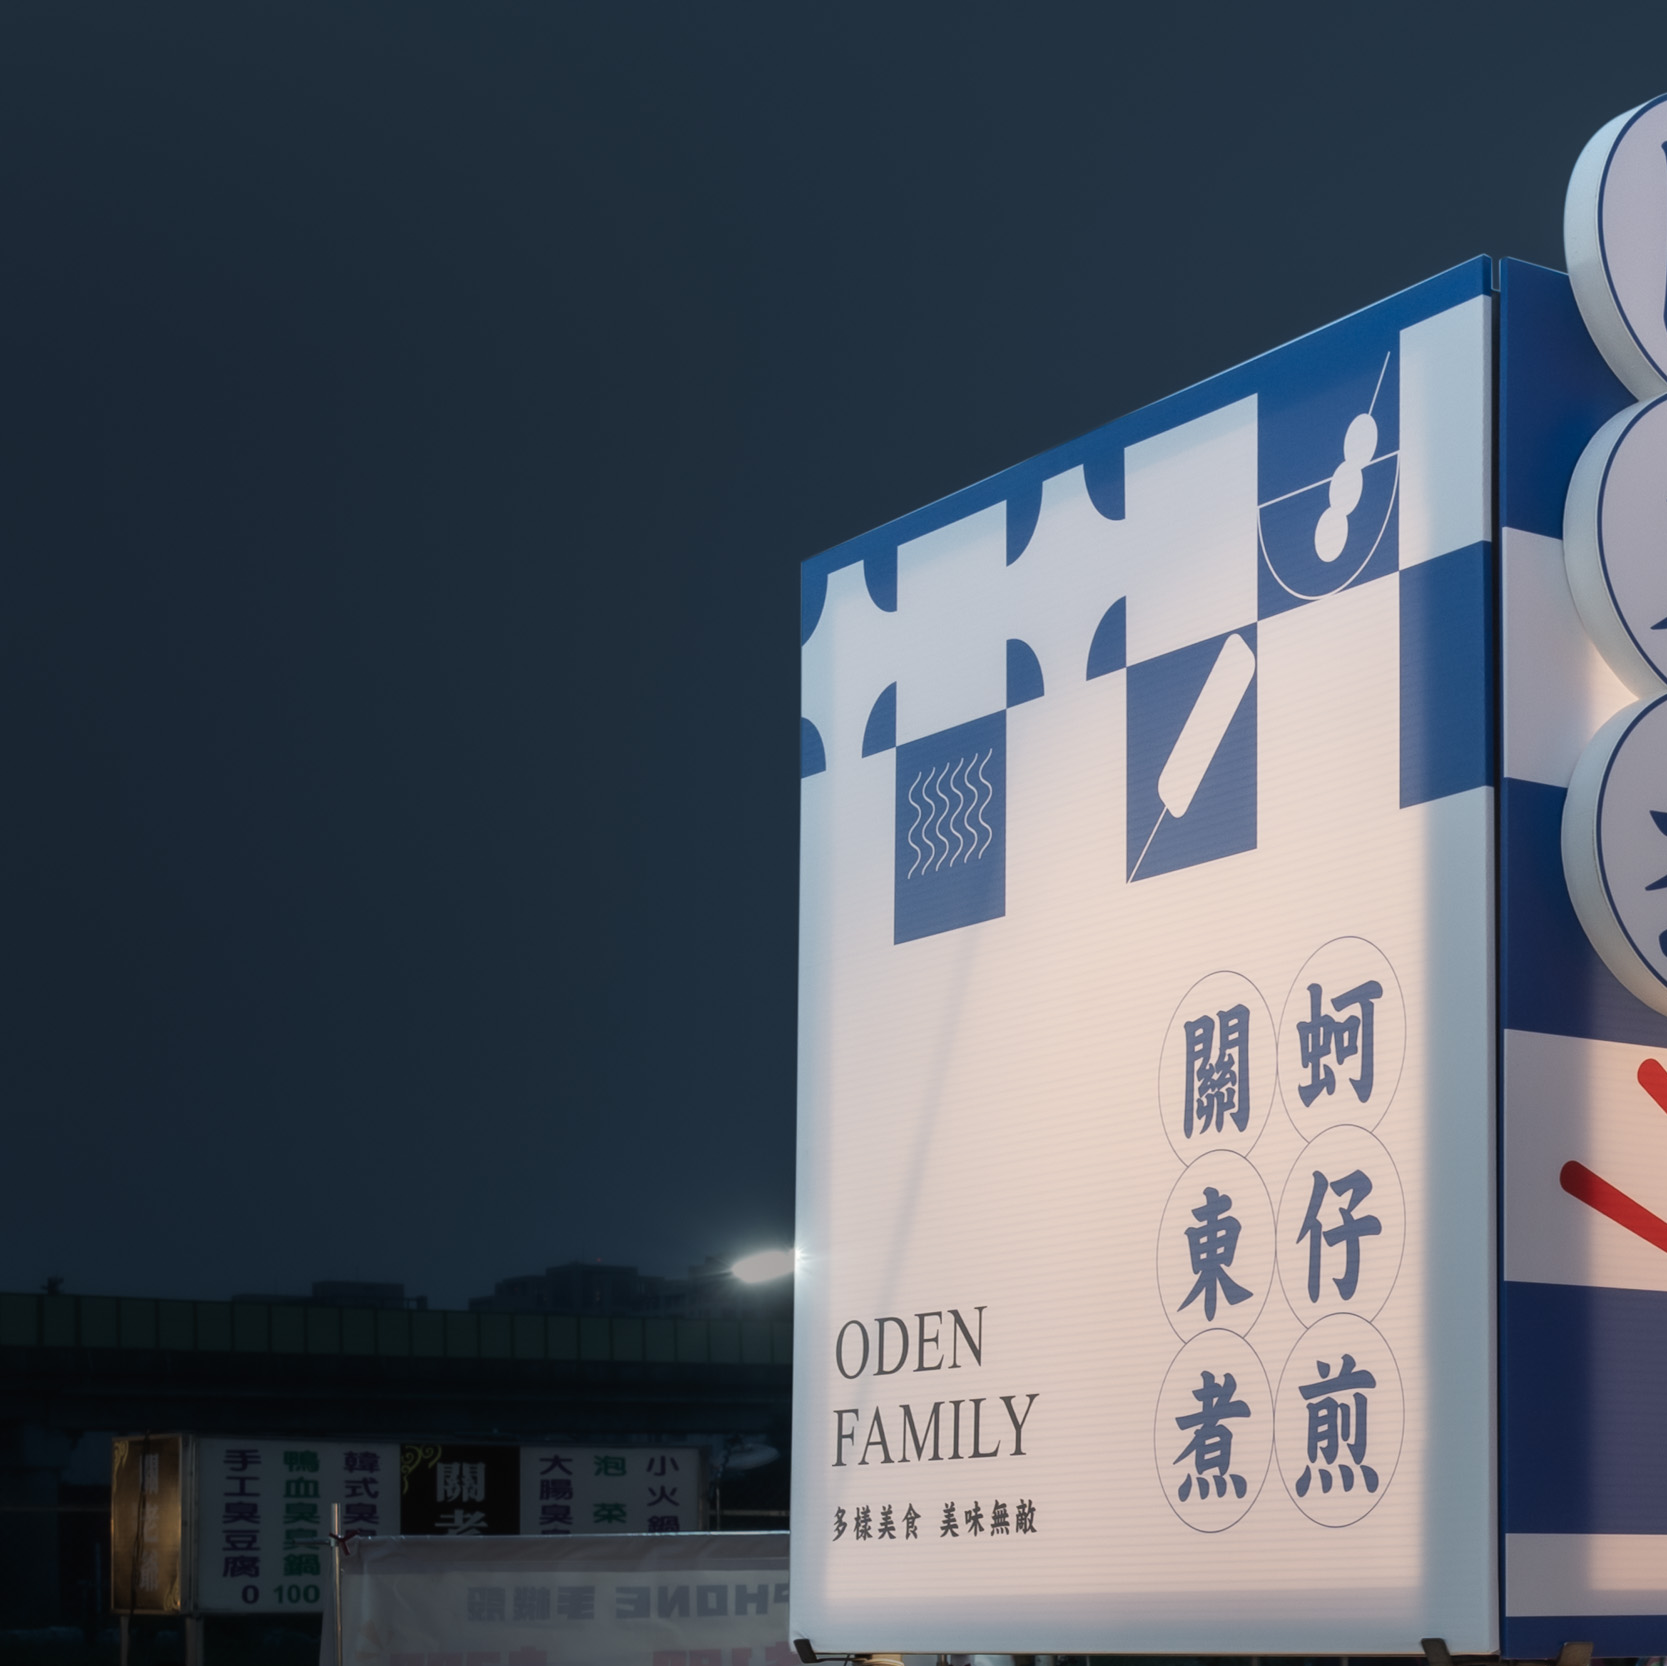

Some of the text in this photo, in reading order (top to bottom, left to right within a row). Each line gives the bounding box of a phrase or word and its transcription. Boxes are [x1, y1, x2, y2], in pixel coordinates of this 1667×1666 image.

[1172, 1003, 1254, 1502] 關東煮
[1295, 980, 1385, 1498] 蚵仔煎
[835, 1306, 988, 1380] ODEN
[831, 1393, 1040, 1468] FAMILY
[222, 1449, 262, 1578] 手工臭豆腐
[539, 1455, 573, 1535] 大腸臭
[832, 1499, 1038, 1542] 多樣美食 美味無敵
[273, 1584, 321, 1604] 100
